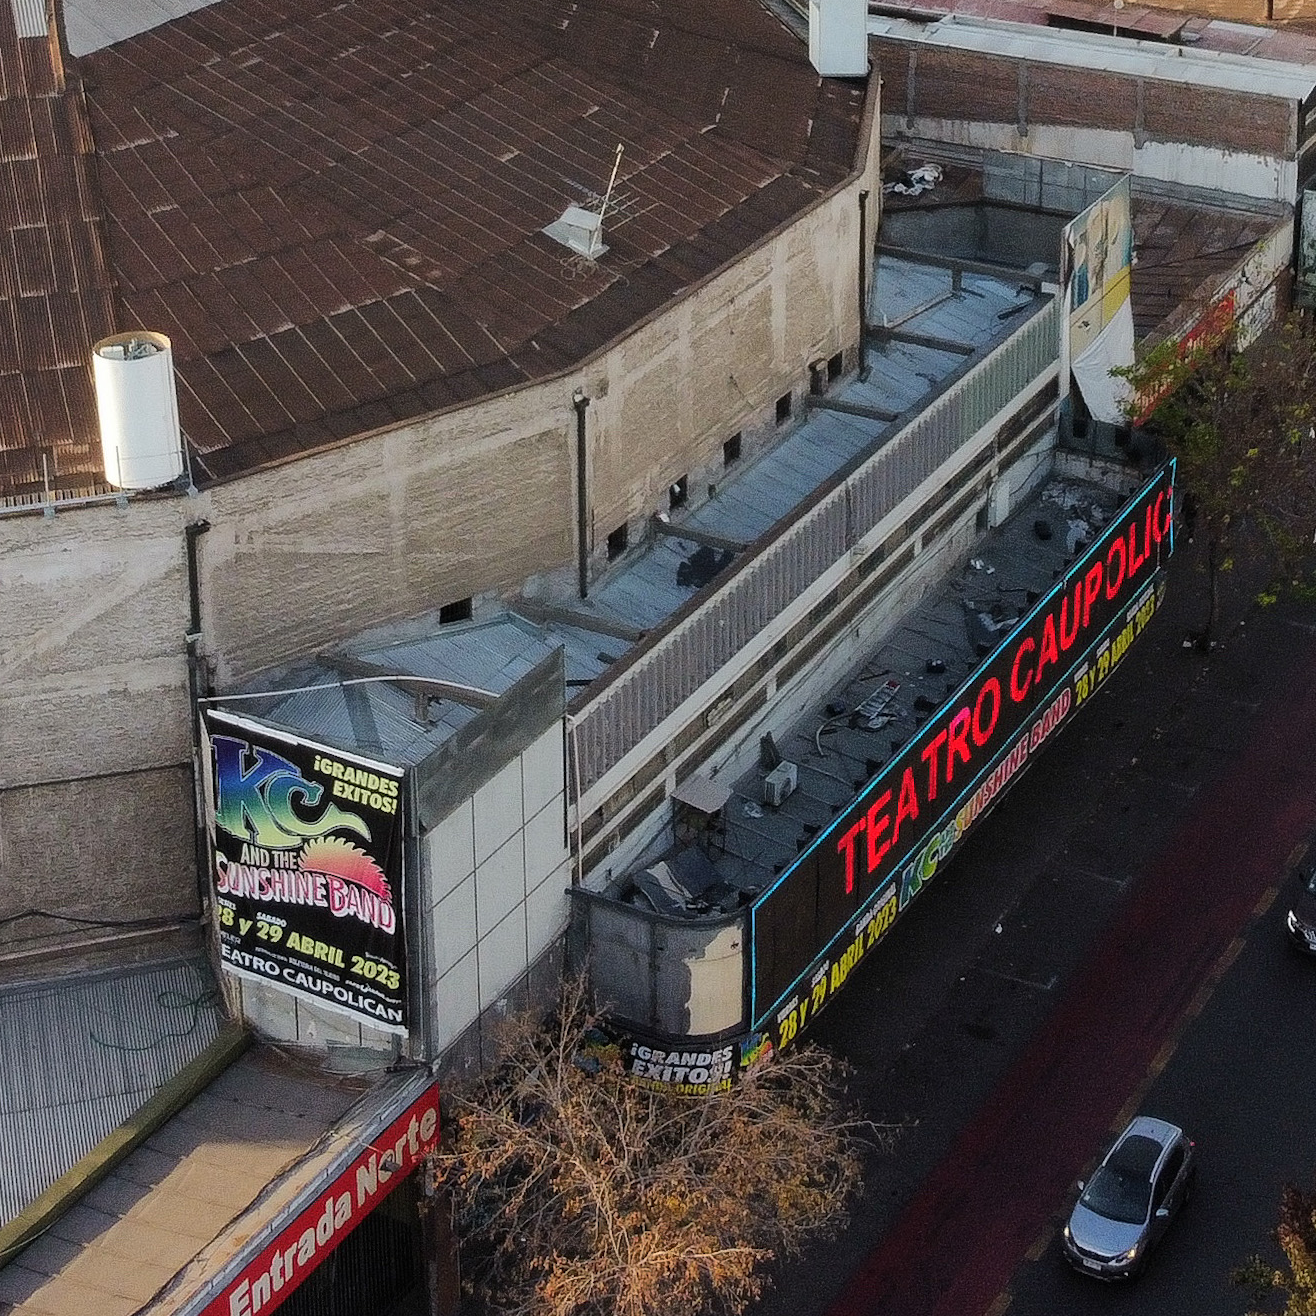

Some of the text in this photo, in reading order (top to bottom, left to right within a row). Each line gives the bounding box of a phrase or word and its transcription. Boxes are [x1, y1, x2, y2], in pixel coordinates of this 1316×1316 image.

[1075, 673, 1089, 707] 28
[209, 734, 372, 849] KC
[313, 755, 399, 797] ¡GRANDES
[332, 780, 398, 816] EXITOS!
[836, 676, 1001, 895] TEATRO
[899, 832, 940, 912] KC
[952, 731, 1030, 843] SUNSHINE
[1029, 687, 1072, 754] BAND
[216, 850, 396, 936] SUNSHINE BAND
[240, 844, 299, 870] AND THE
[221, 944, 280, 975] EATRO
[282, 969, 403, 1022] CAUPOLICAN
[257, 921, 283, 942] 29
[286, 932, 345, 969] ABRIL
[351, 955, 401, 991] 2023
[779, 896, 897, 1050] 28 Y 29 ABRIL 2023
[228, 1106, 437, 1316] Entrada Norte
